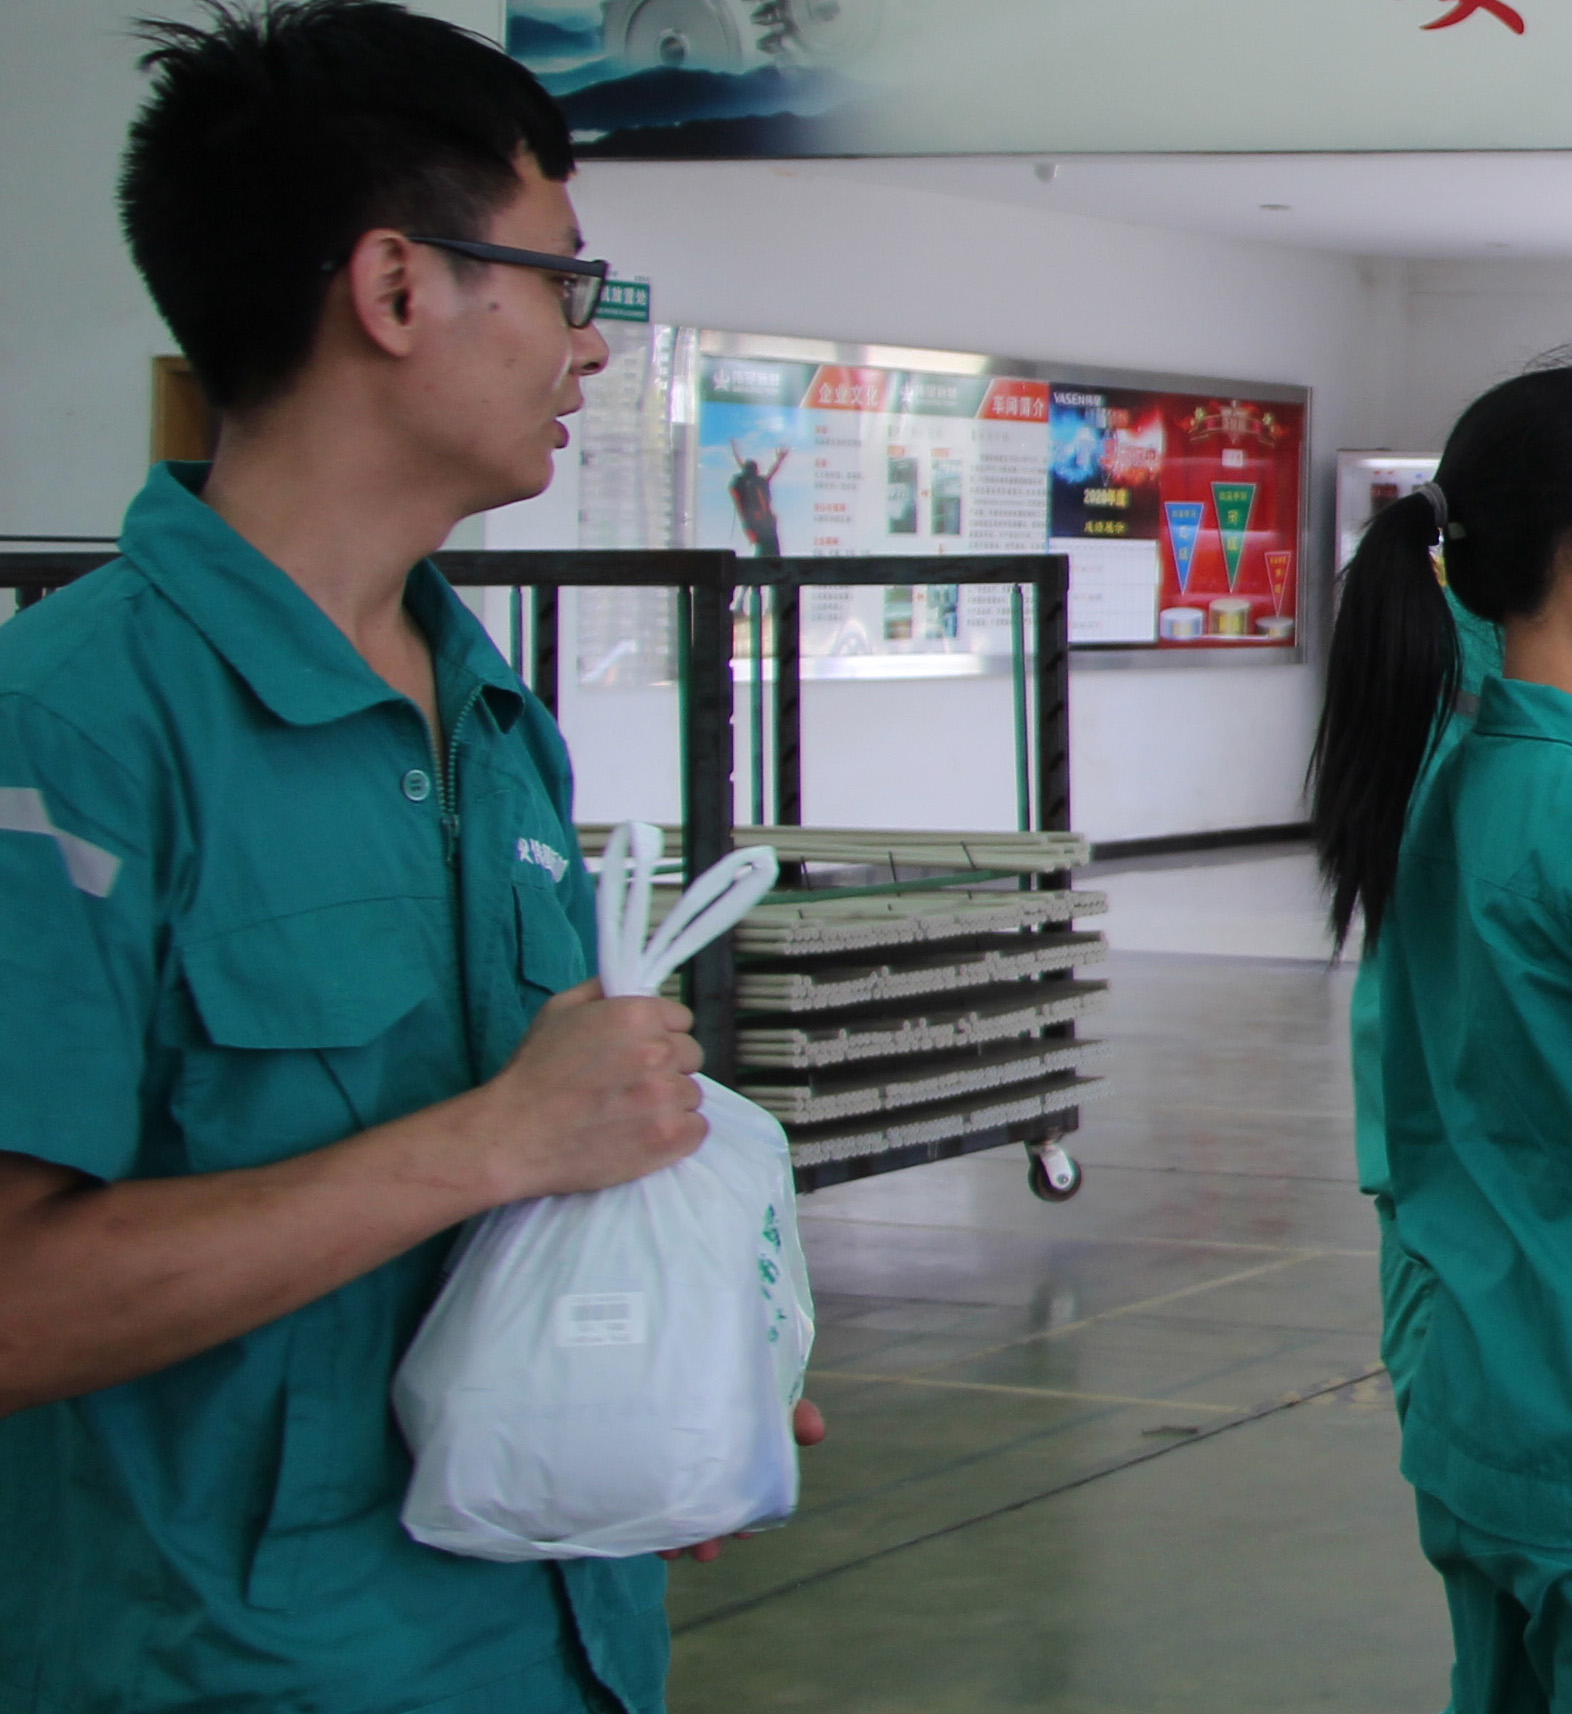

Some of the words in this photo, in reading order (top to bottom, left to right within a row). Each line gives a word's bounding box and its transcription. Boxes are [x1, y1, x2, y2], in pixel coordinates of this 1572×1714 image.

[818, 382, 879, 406] 企业文化
[992, 395, 1045, 418] 车间简介
